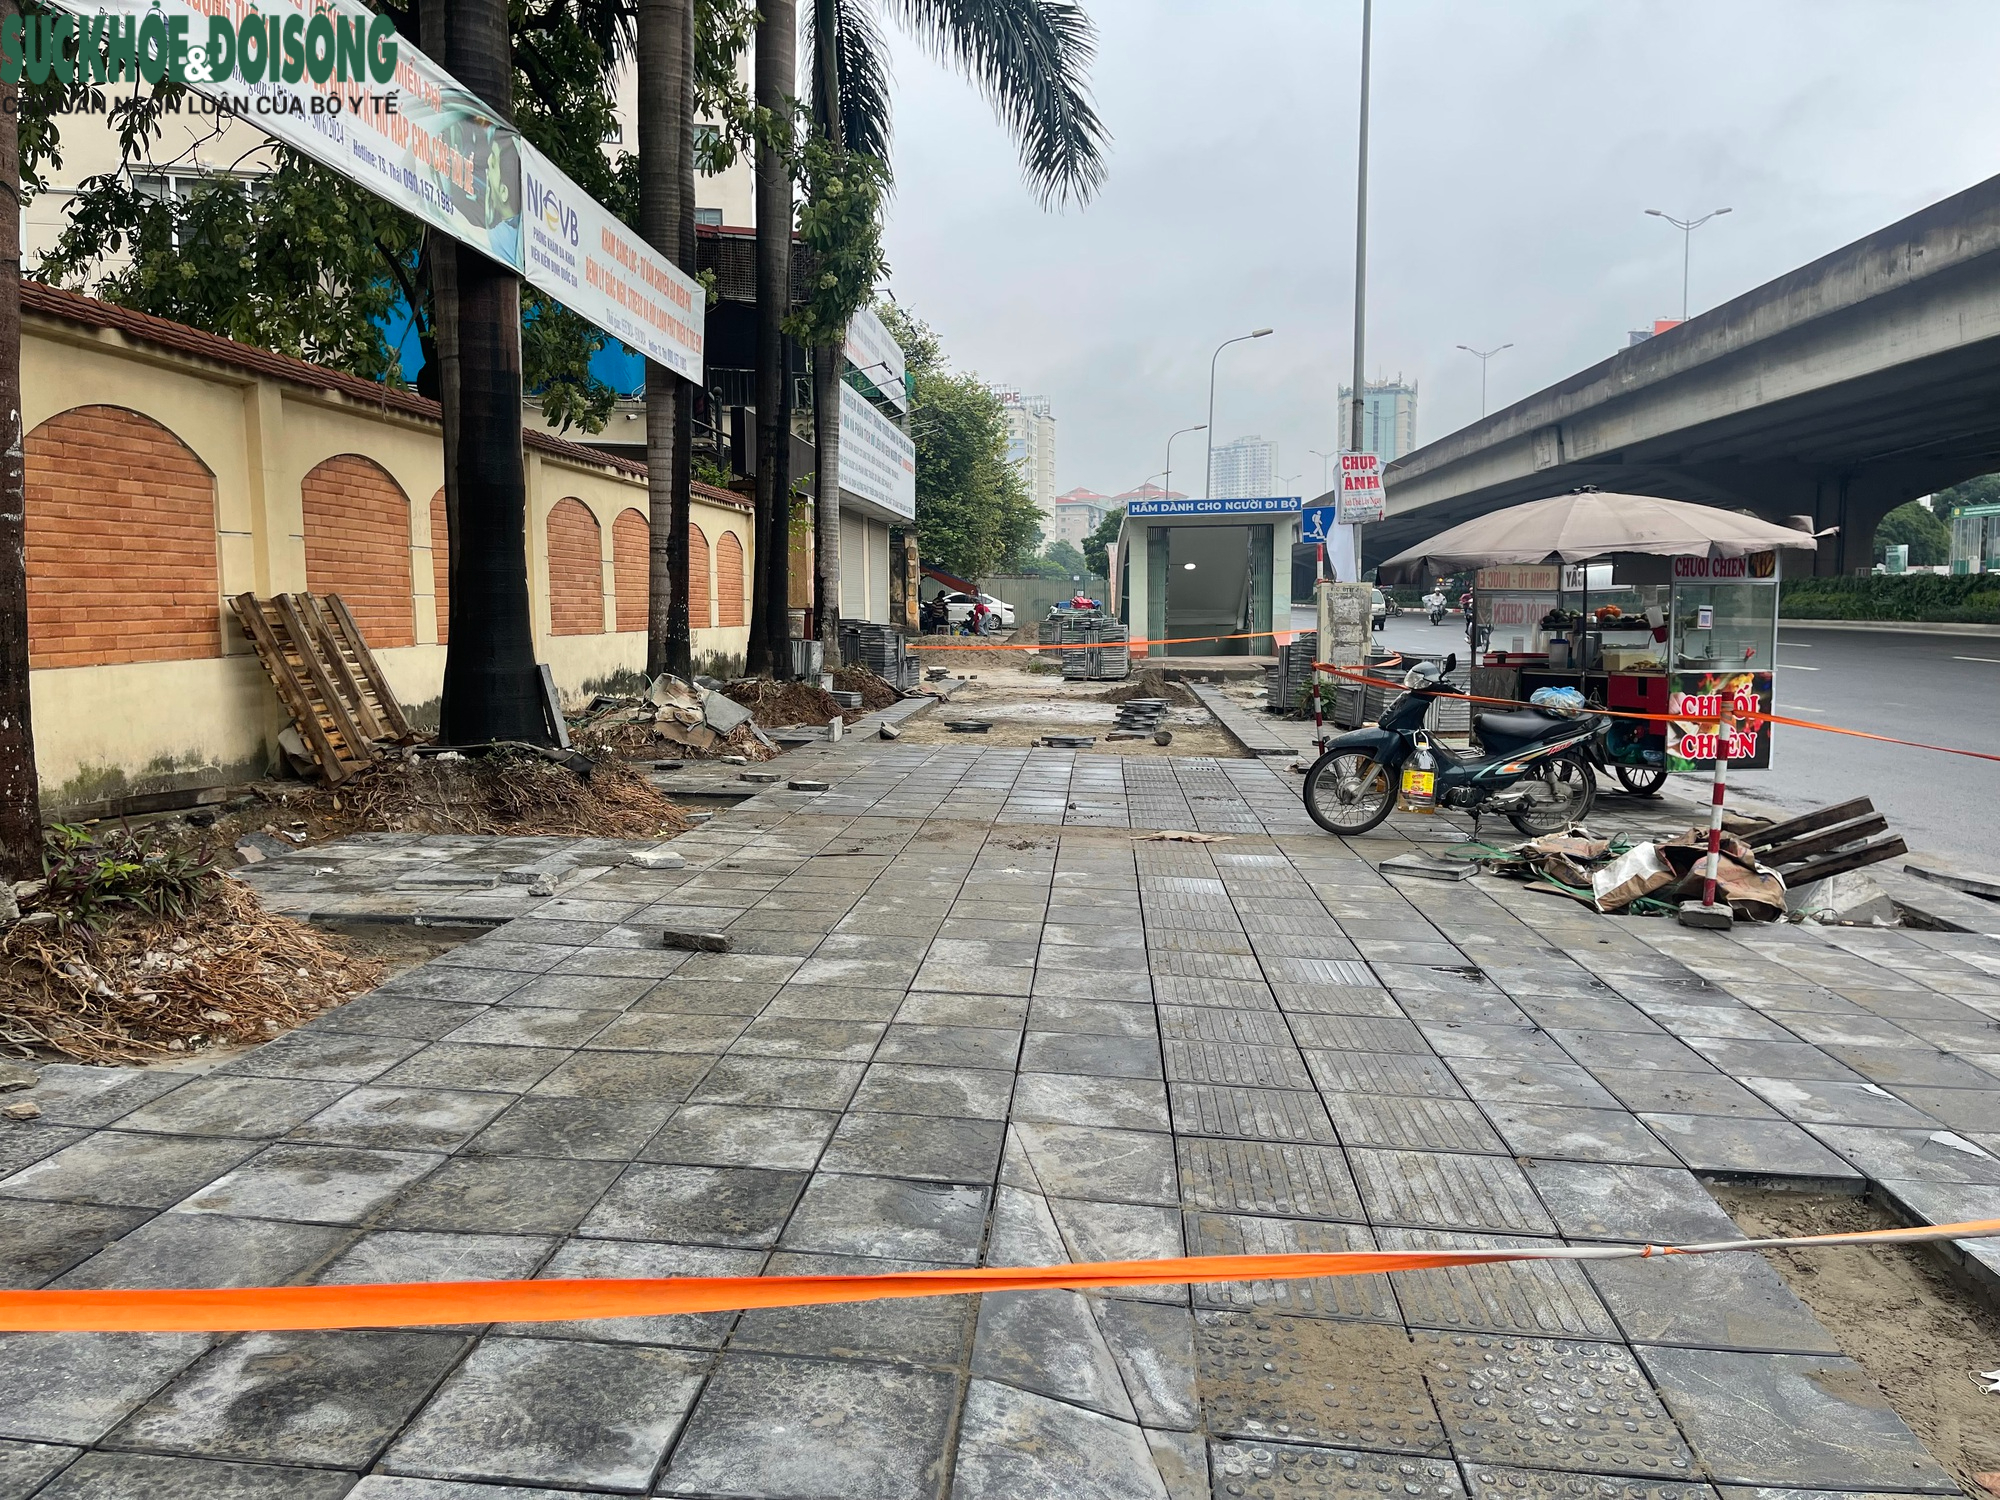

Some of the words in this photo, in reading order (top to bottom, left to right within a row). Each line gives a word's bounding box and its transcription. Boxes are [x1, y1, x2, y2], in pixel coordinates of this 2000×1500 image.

[352, 138, 377, 172] Hotline:
[377, 155, 389, 175] TS.
[411, 122, 431, 166] CHO
[628, 286, 643, 319] STRESS
[1342, 455, 1377, 473] CHỤP
[1344, 472, 1380, 490] ẢNH
[1131, 501, 1158, 513] HẦM
[1161, 501, 1194, 512] DÀNH
[1196, 502, 1222, 511] CHO
[1225, 498, 1262, 510] NGƯỜI
[1264, 500, 1278, 509] ĐI
[1281, 497, 1298, 511] BỘ
